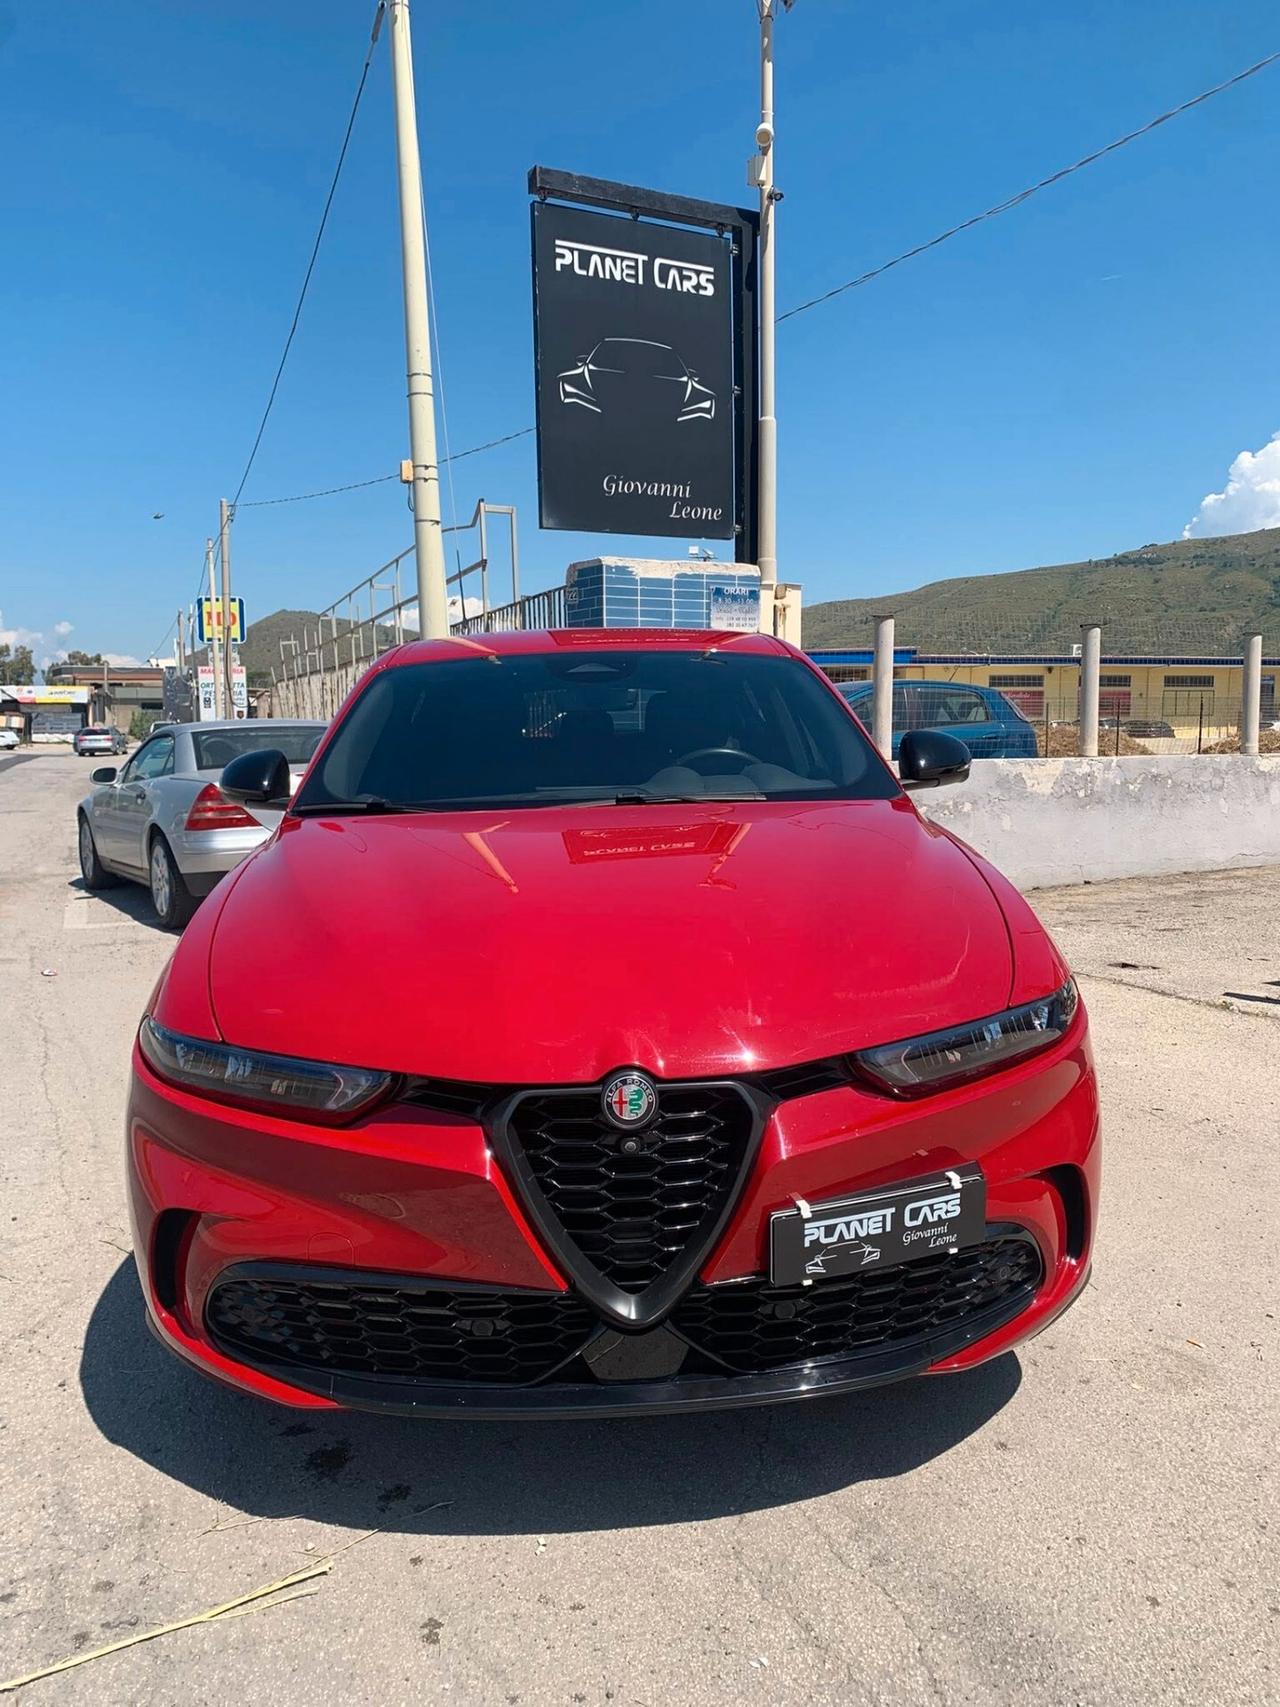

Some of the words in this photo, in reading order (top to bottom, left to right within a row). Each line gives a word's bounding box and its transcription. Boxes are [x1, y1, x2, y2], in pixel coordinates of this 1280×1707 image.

[555, 240, 649, 285] PLANET
[654, 257, 715, 297] CARS
[603, 475, 691, 499] Giovanni
[669, 502, 723, 521] Leone
[724, 587, 748, 595] ORARI
[606, 1081, 624, 1104] ALFA
[626, 1078, 654, 1103] ROMEO
[804, 1206, 897, 1248] PLANET
[904, 1192, 961, 1227] CARS
[902, 1222, 949, 1246] Giovanni
[928, 1233, 958, 1249] Leone
